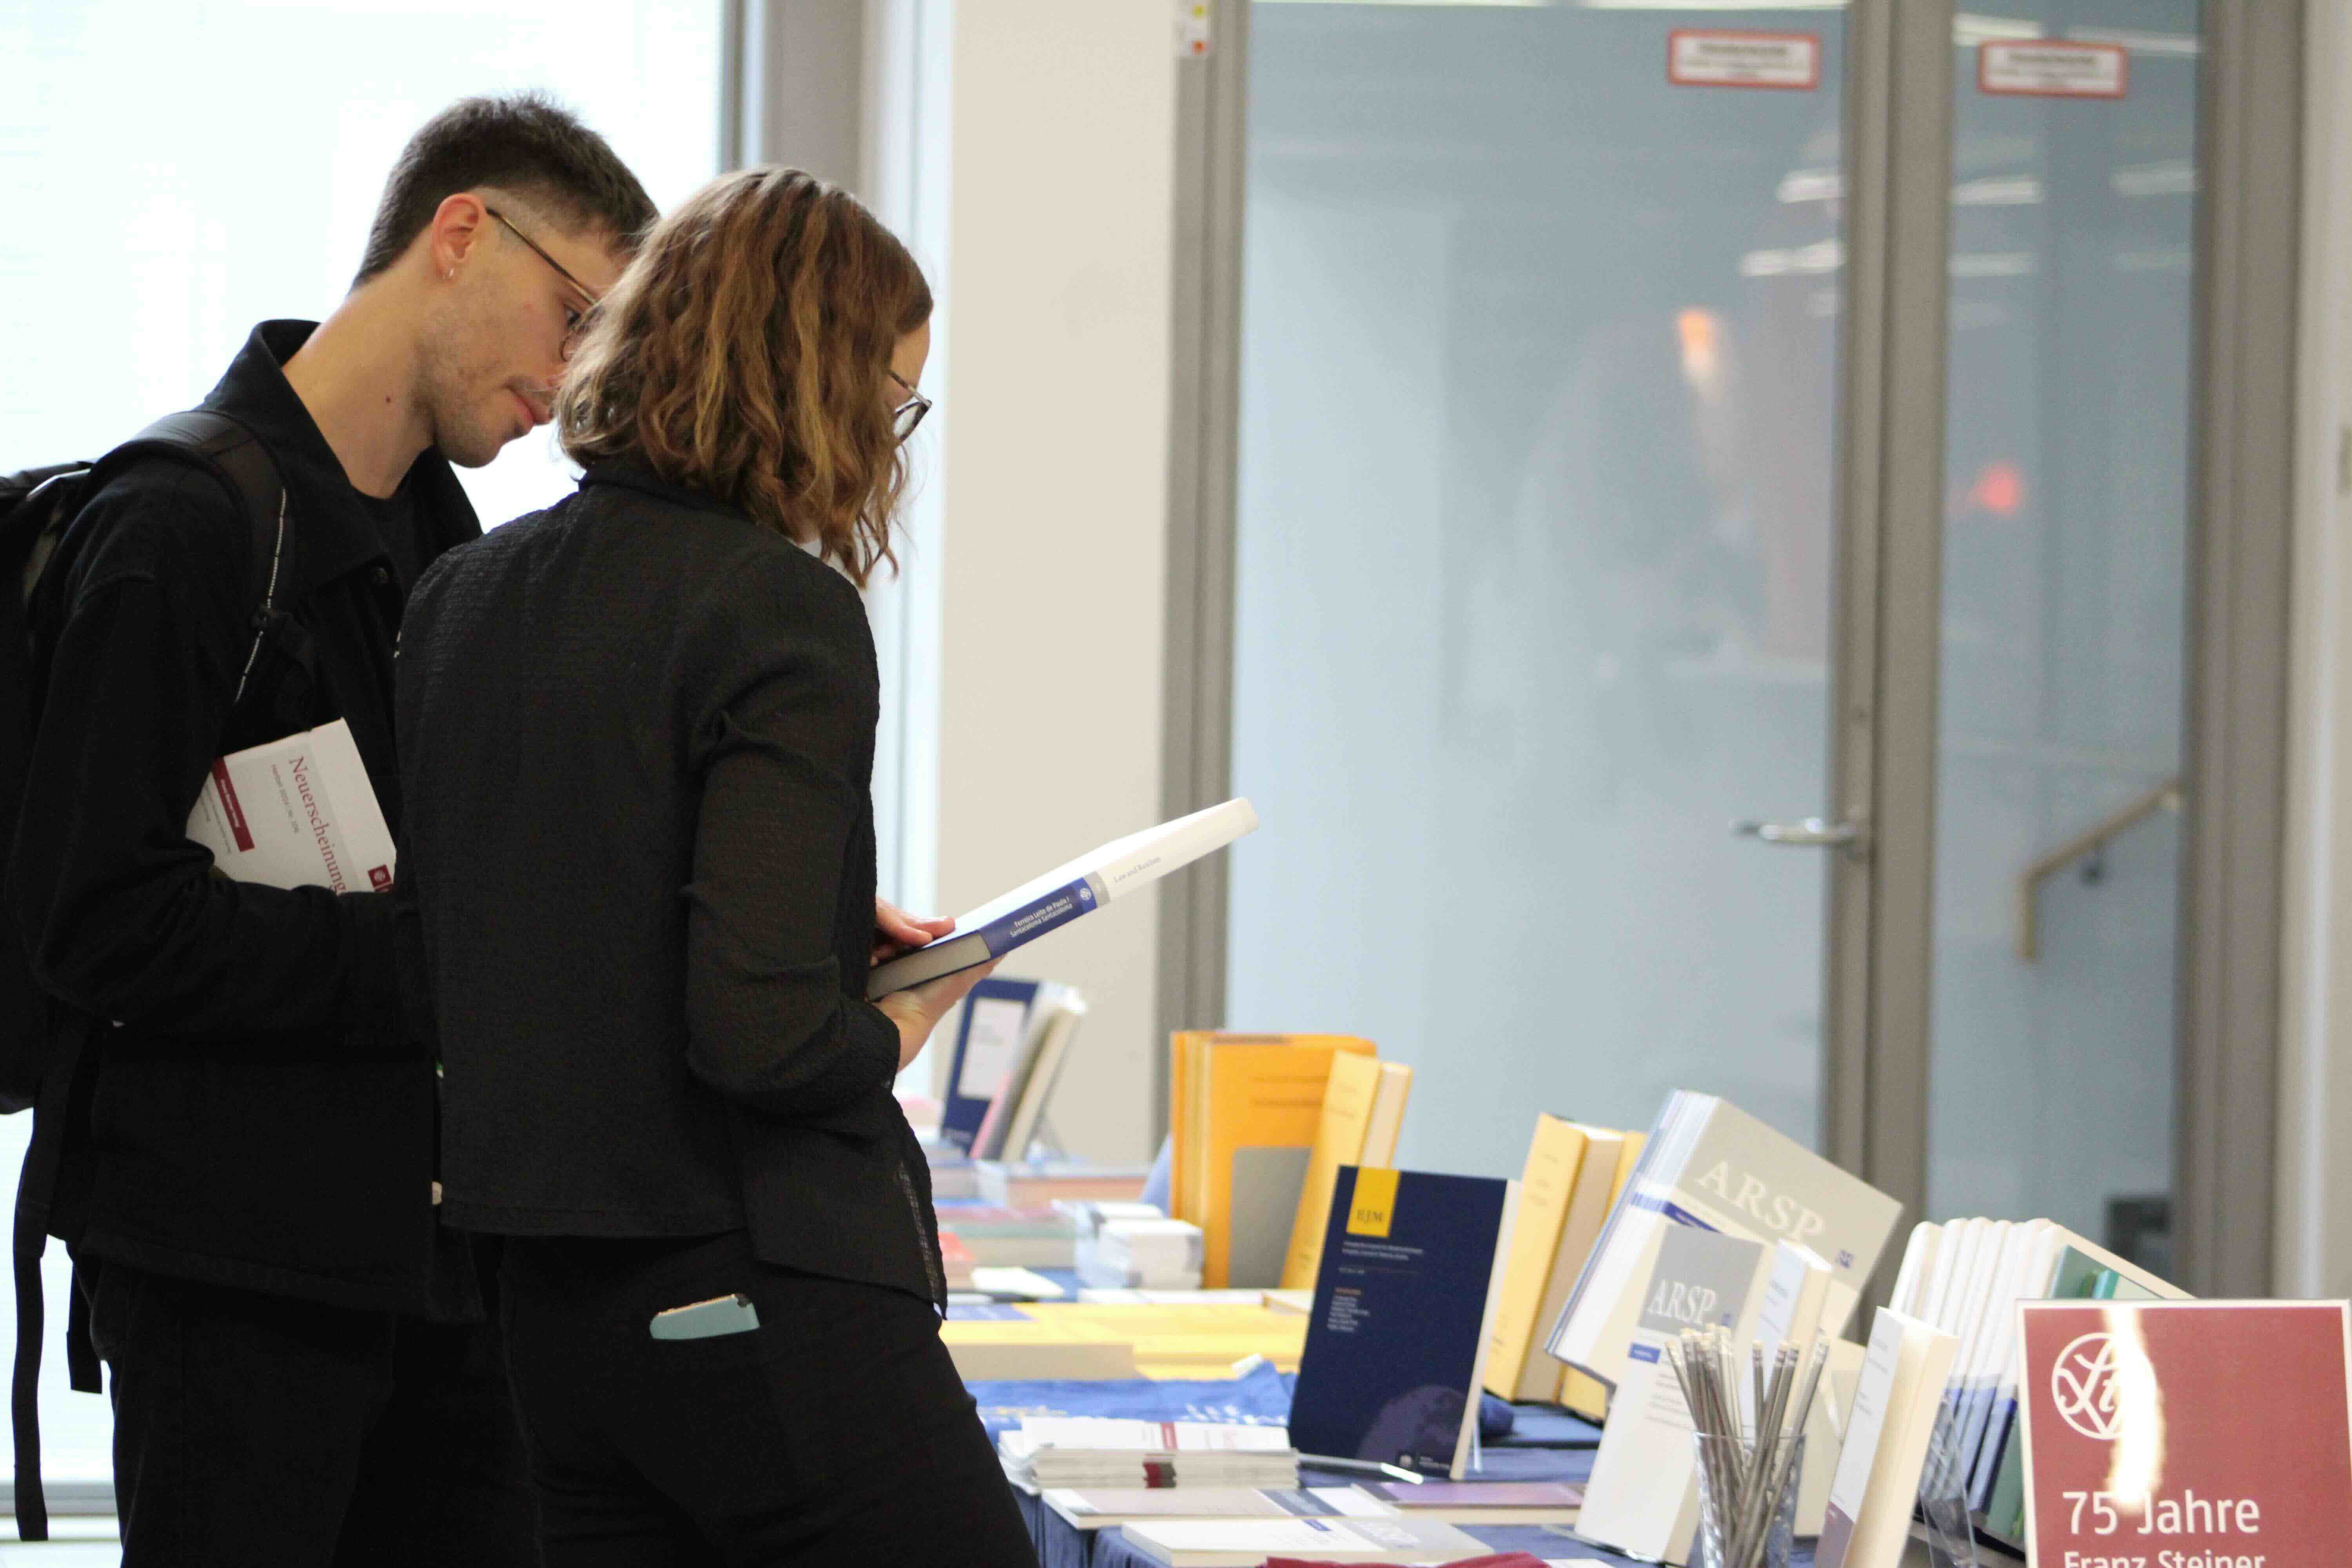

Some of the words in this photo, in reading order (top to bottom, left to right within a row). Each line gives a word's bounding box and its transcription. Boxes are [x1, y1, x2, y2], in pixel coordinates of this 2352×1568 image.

[1695, 1160, 1825, 1241] ARSP
[1646, 1279, 1716, 1324] ARSP
[2062, 1491, 2118, 1535] 75
[2136, 1489, 2261, 1535] Jahre
